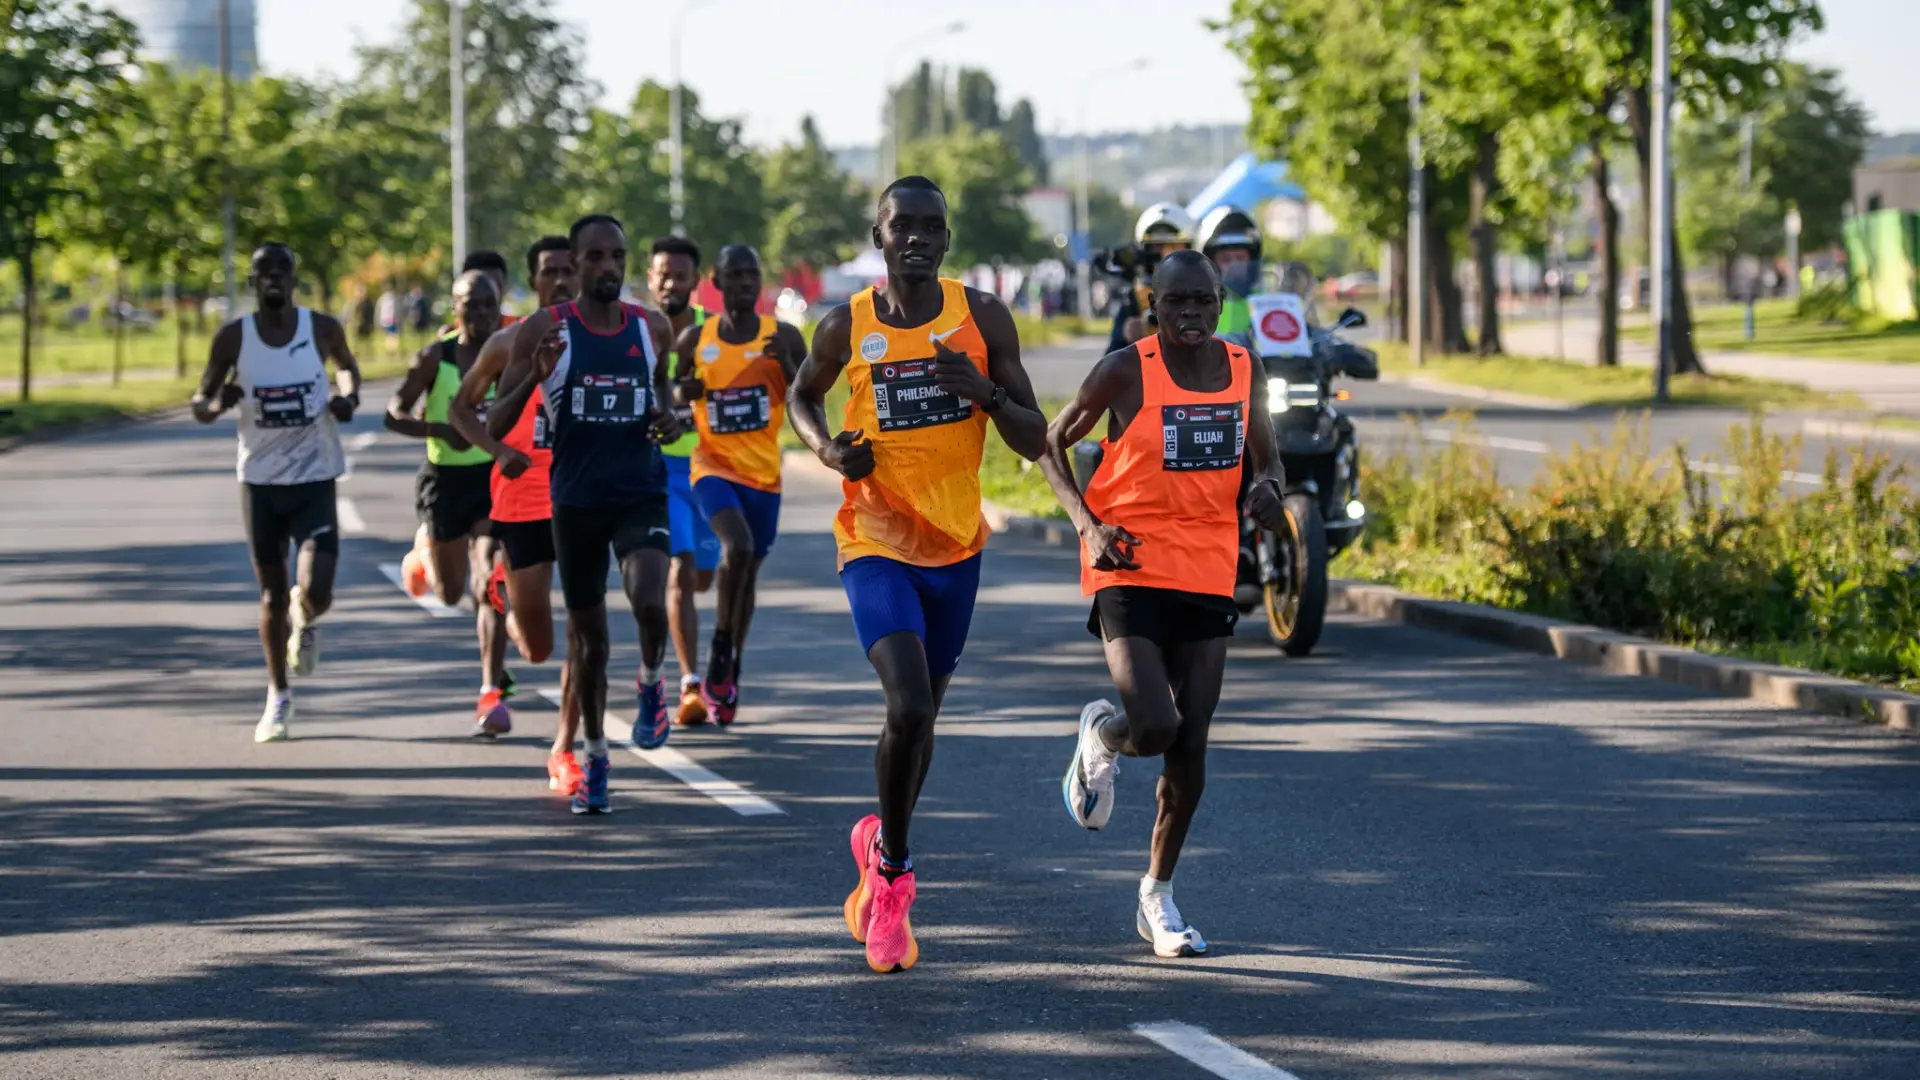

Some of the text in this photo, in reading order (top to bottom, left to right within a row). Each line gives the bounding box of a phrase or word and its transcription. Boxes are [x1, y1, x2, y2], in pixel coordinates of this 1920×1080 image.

[602, 394, 618, 410] 17
[920, 402, 928, 411] 15
[1193, 431, 1224, 444] ELIJAH
[1205, 446, 1212, 454] 16
